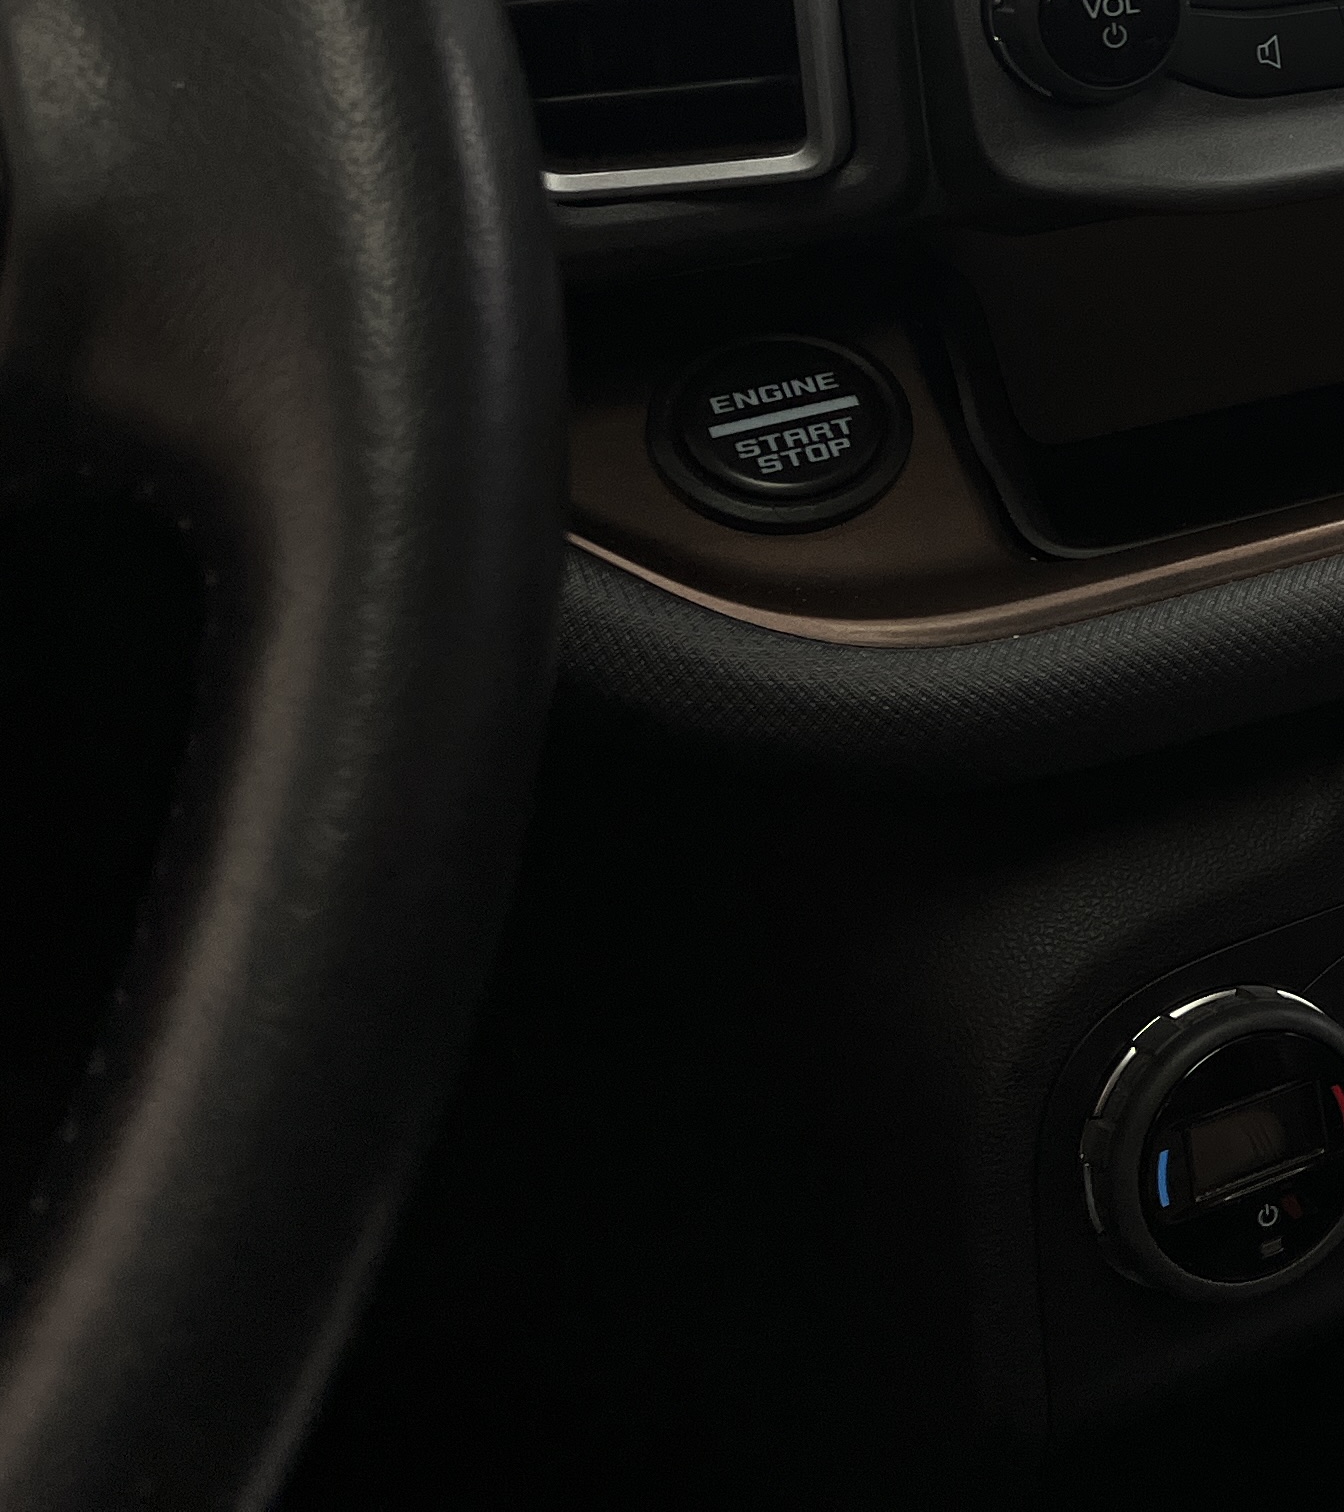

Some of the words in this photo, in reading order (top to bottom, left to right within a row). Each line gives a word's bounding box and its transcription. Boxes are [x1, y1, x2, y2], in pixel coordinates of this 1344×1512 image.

[708, 371, 840, 415] ENGINE
[734, 416, 853, 459] START
[757, 437, 851, 474] STOP
